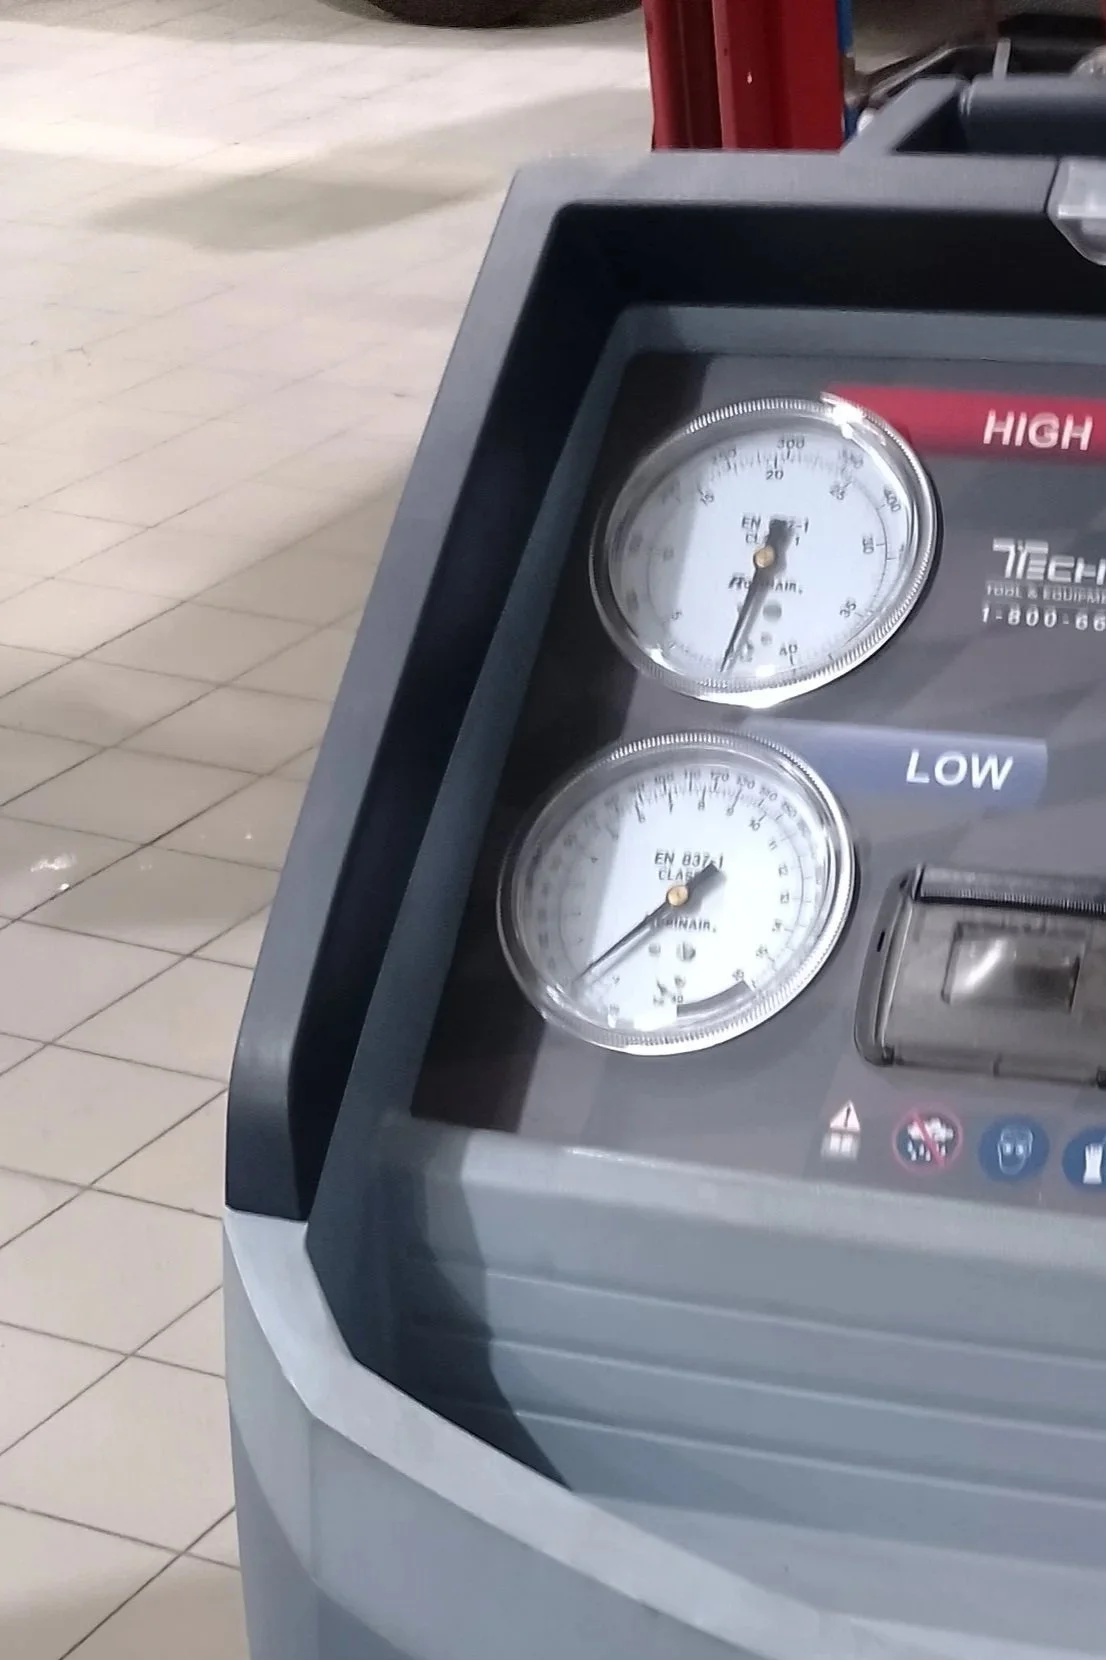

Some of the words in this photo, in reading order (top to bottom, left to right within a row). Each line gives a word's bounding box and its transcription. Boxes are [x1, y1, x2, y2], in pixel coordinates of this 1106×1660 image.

[982, 409, 1094, 451] HIGH
[765, 470, 784, 480] 20
[741, 516, 761, 529] EN
[986, 583, 1023, 599] TOOL
[1028, 585, 1038, 599] &
[906, 749, 1014, 790] LOW
[655, 851, 675, 865] EN
